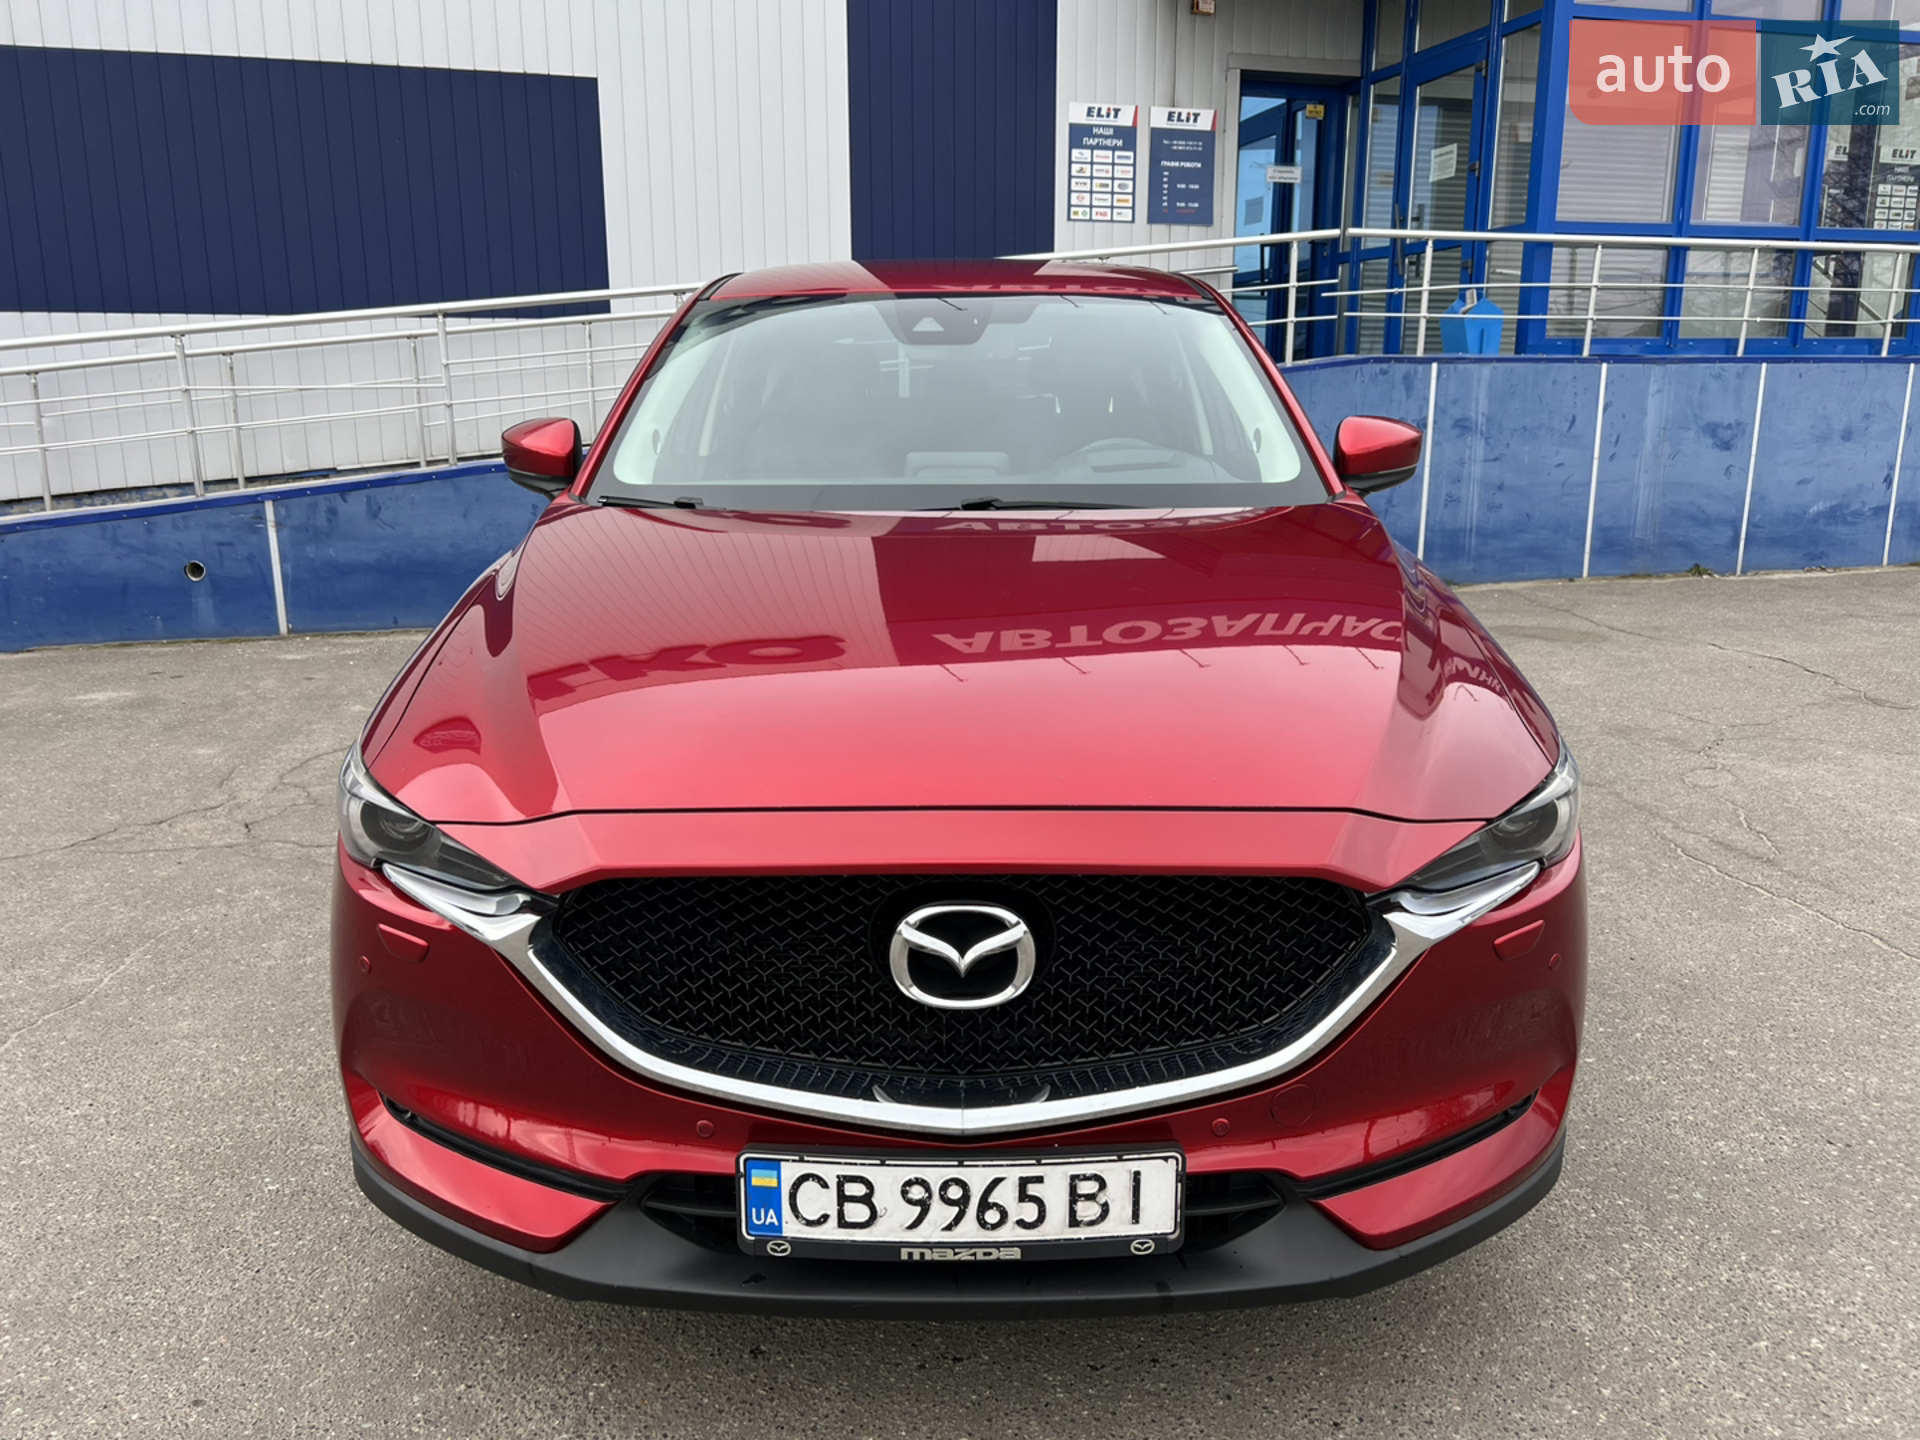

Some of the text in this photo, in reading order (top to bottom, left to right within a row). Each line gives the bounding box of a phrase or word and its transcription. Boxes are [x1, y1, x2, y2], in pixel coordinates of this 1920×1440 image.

[1082, 136, 1124, 147] ПАРТНЕРИ
[788, 1169, 1142, 1233] CB 9965 BI
[751, 1205, 779, 1226] UA
